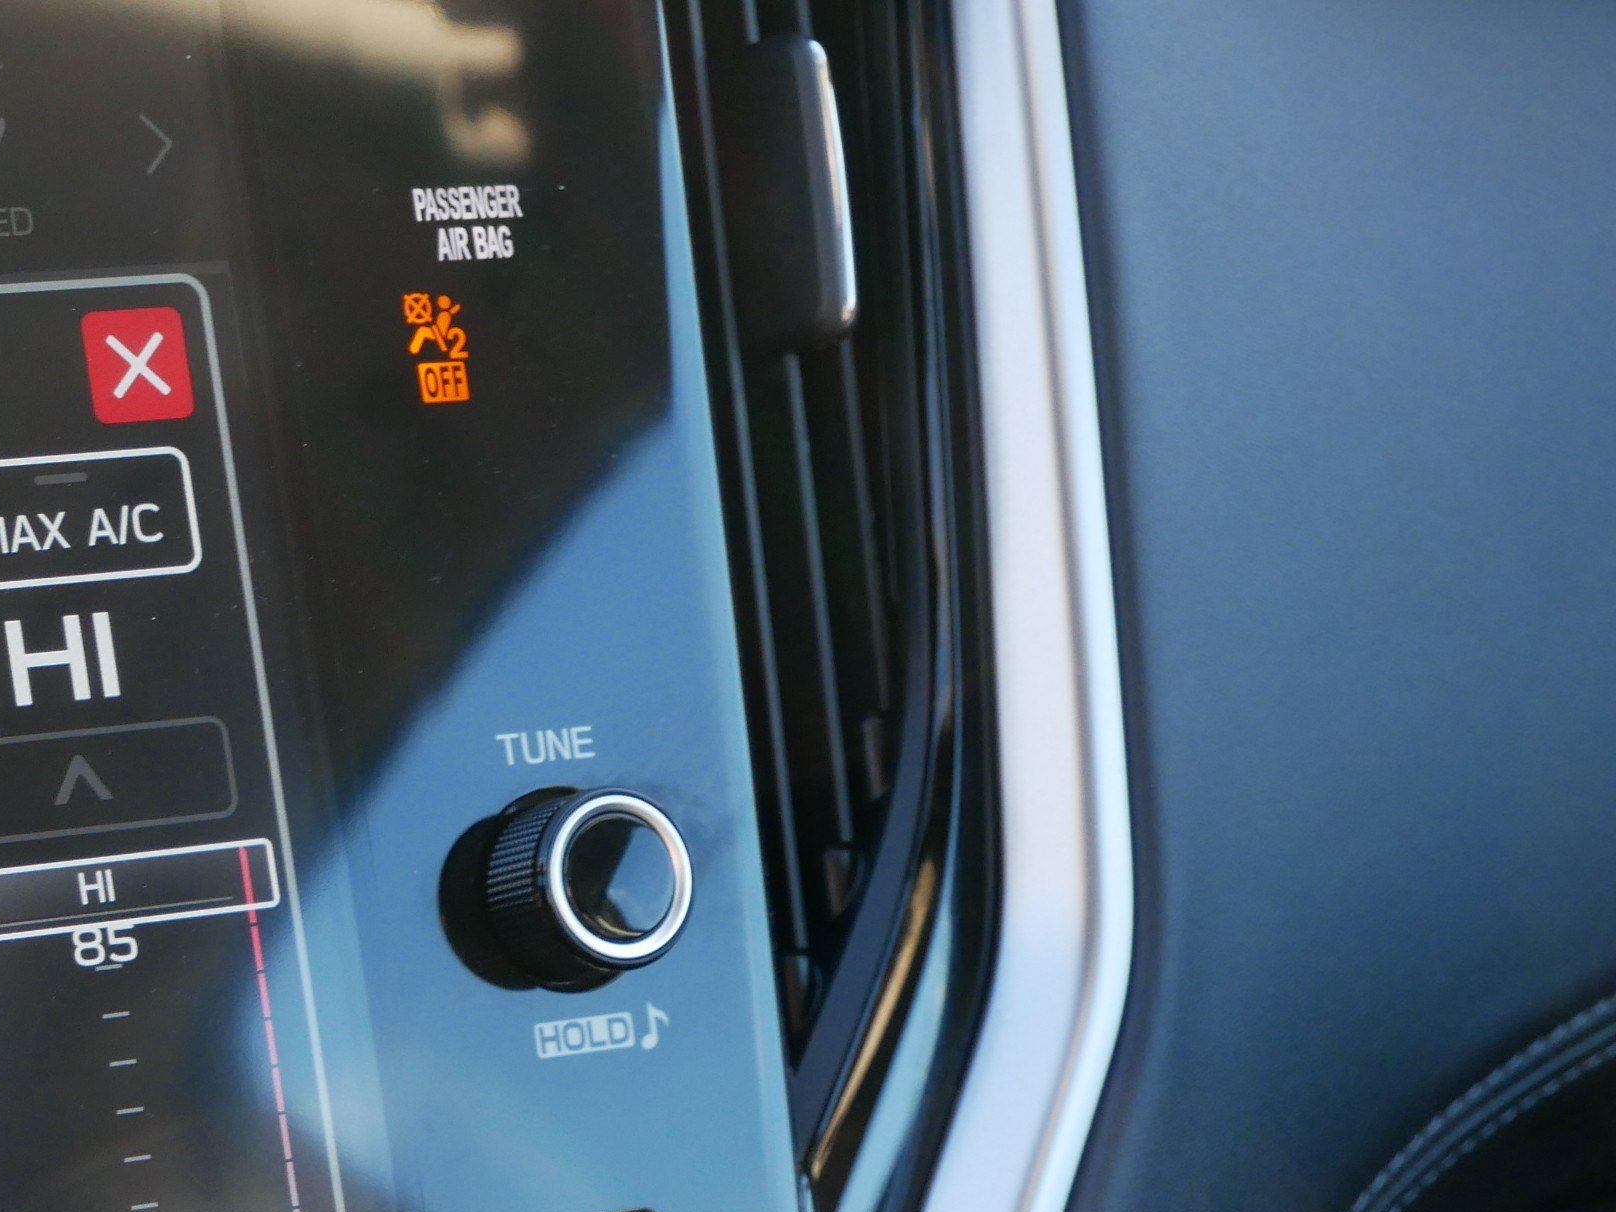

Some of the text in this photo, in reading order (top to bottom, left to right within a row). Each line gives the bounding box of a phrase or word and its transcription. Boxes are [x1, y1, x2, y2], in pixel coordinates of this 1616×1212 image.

[412, 184, 523, 222] PASSENGER
[438, 225, 514, 261] AIR BAG
[424, 365, 464, 398] OFF
[88, 503, 164, 547] A/C
[3, 611, 121, 707] HI
[495, 725, 596, 766] TUNE
[77, 868, 116, 905] HI
[72, 926, 139, 966] 85
[539, 1018, 631, 1054] HOLD
